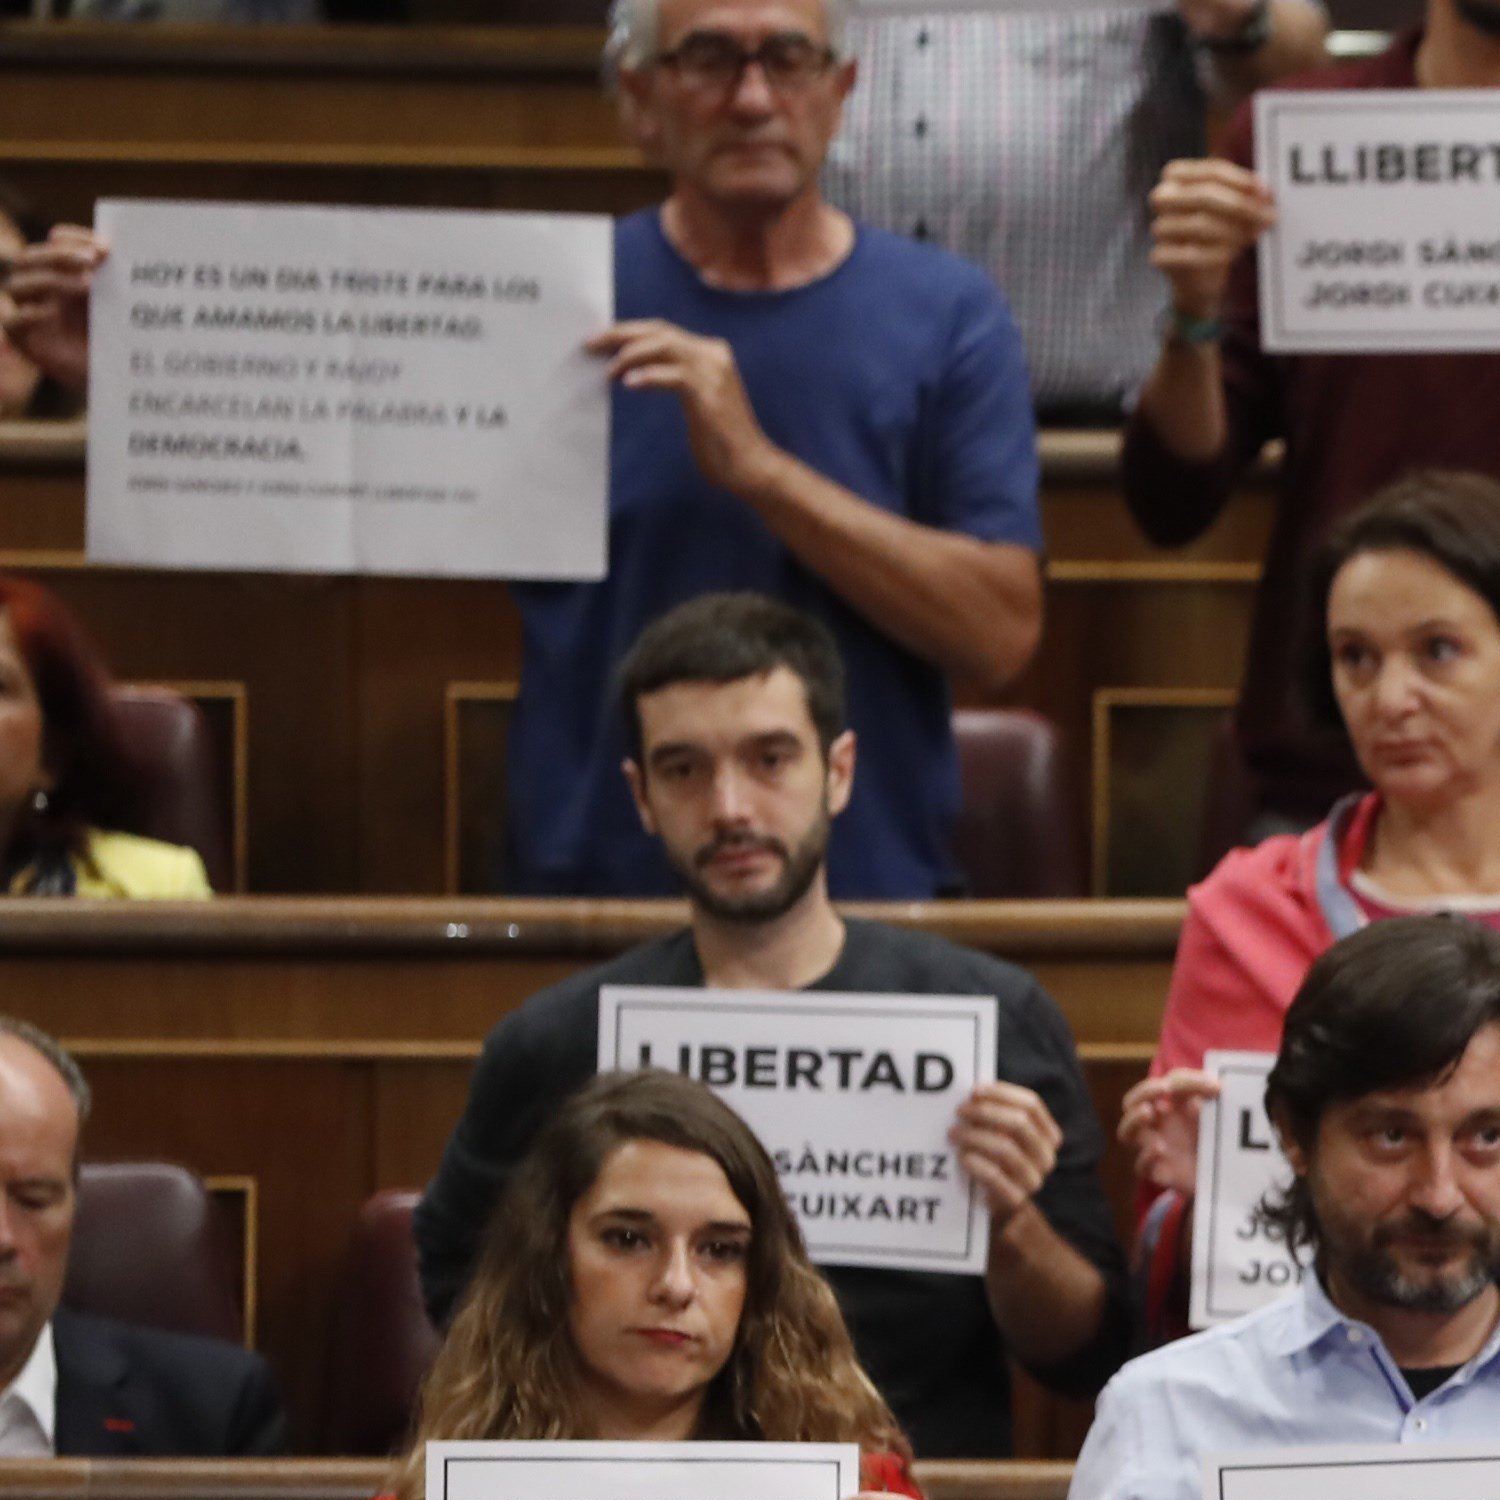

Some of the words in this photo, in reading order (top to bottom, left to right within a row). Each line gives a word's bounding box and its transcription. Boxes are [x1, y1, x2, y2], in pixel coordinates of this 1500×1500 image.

[1301, 241, 1403, 267] JORDI
[1307, 283, 1410, 307] JORDI
[788, 1194, 941, 1224] UIXART
